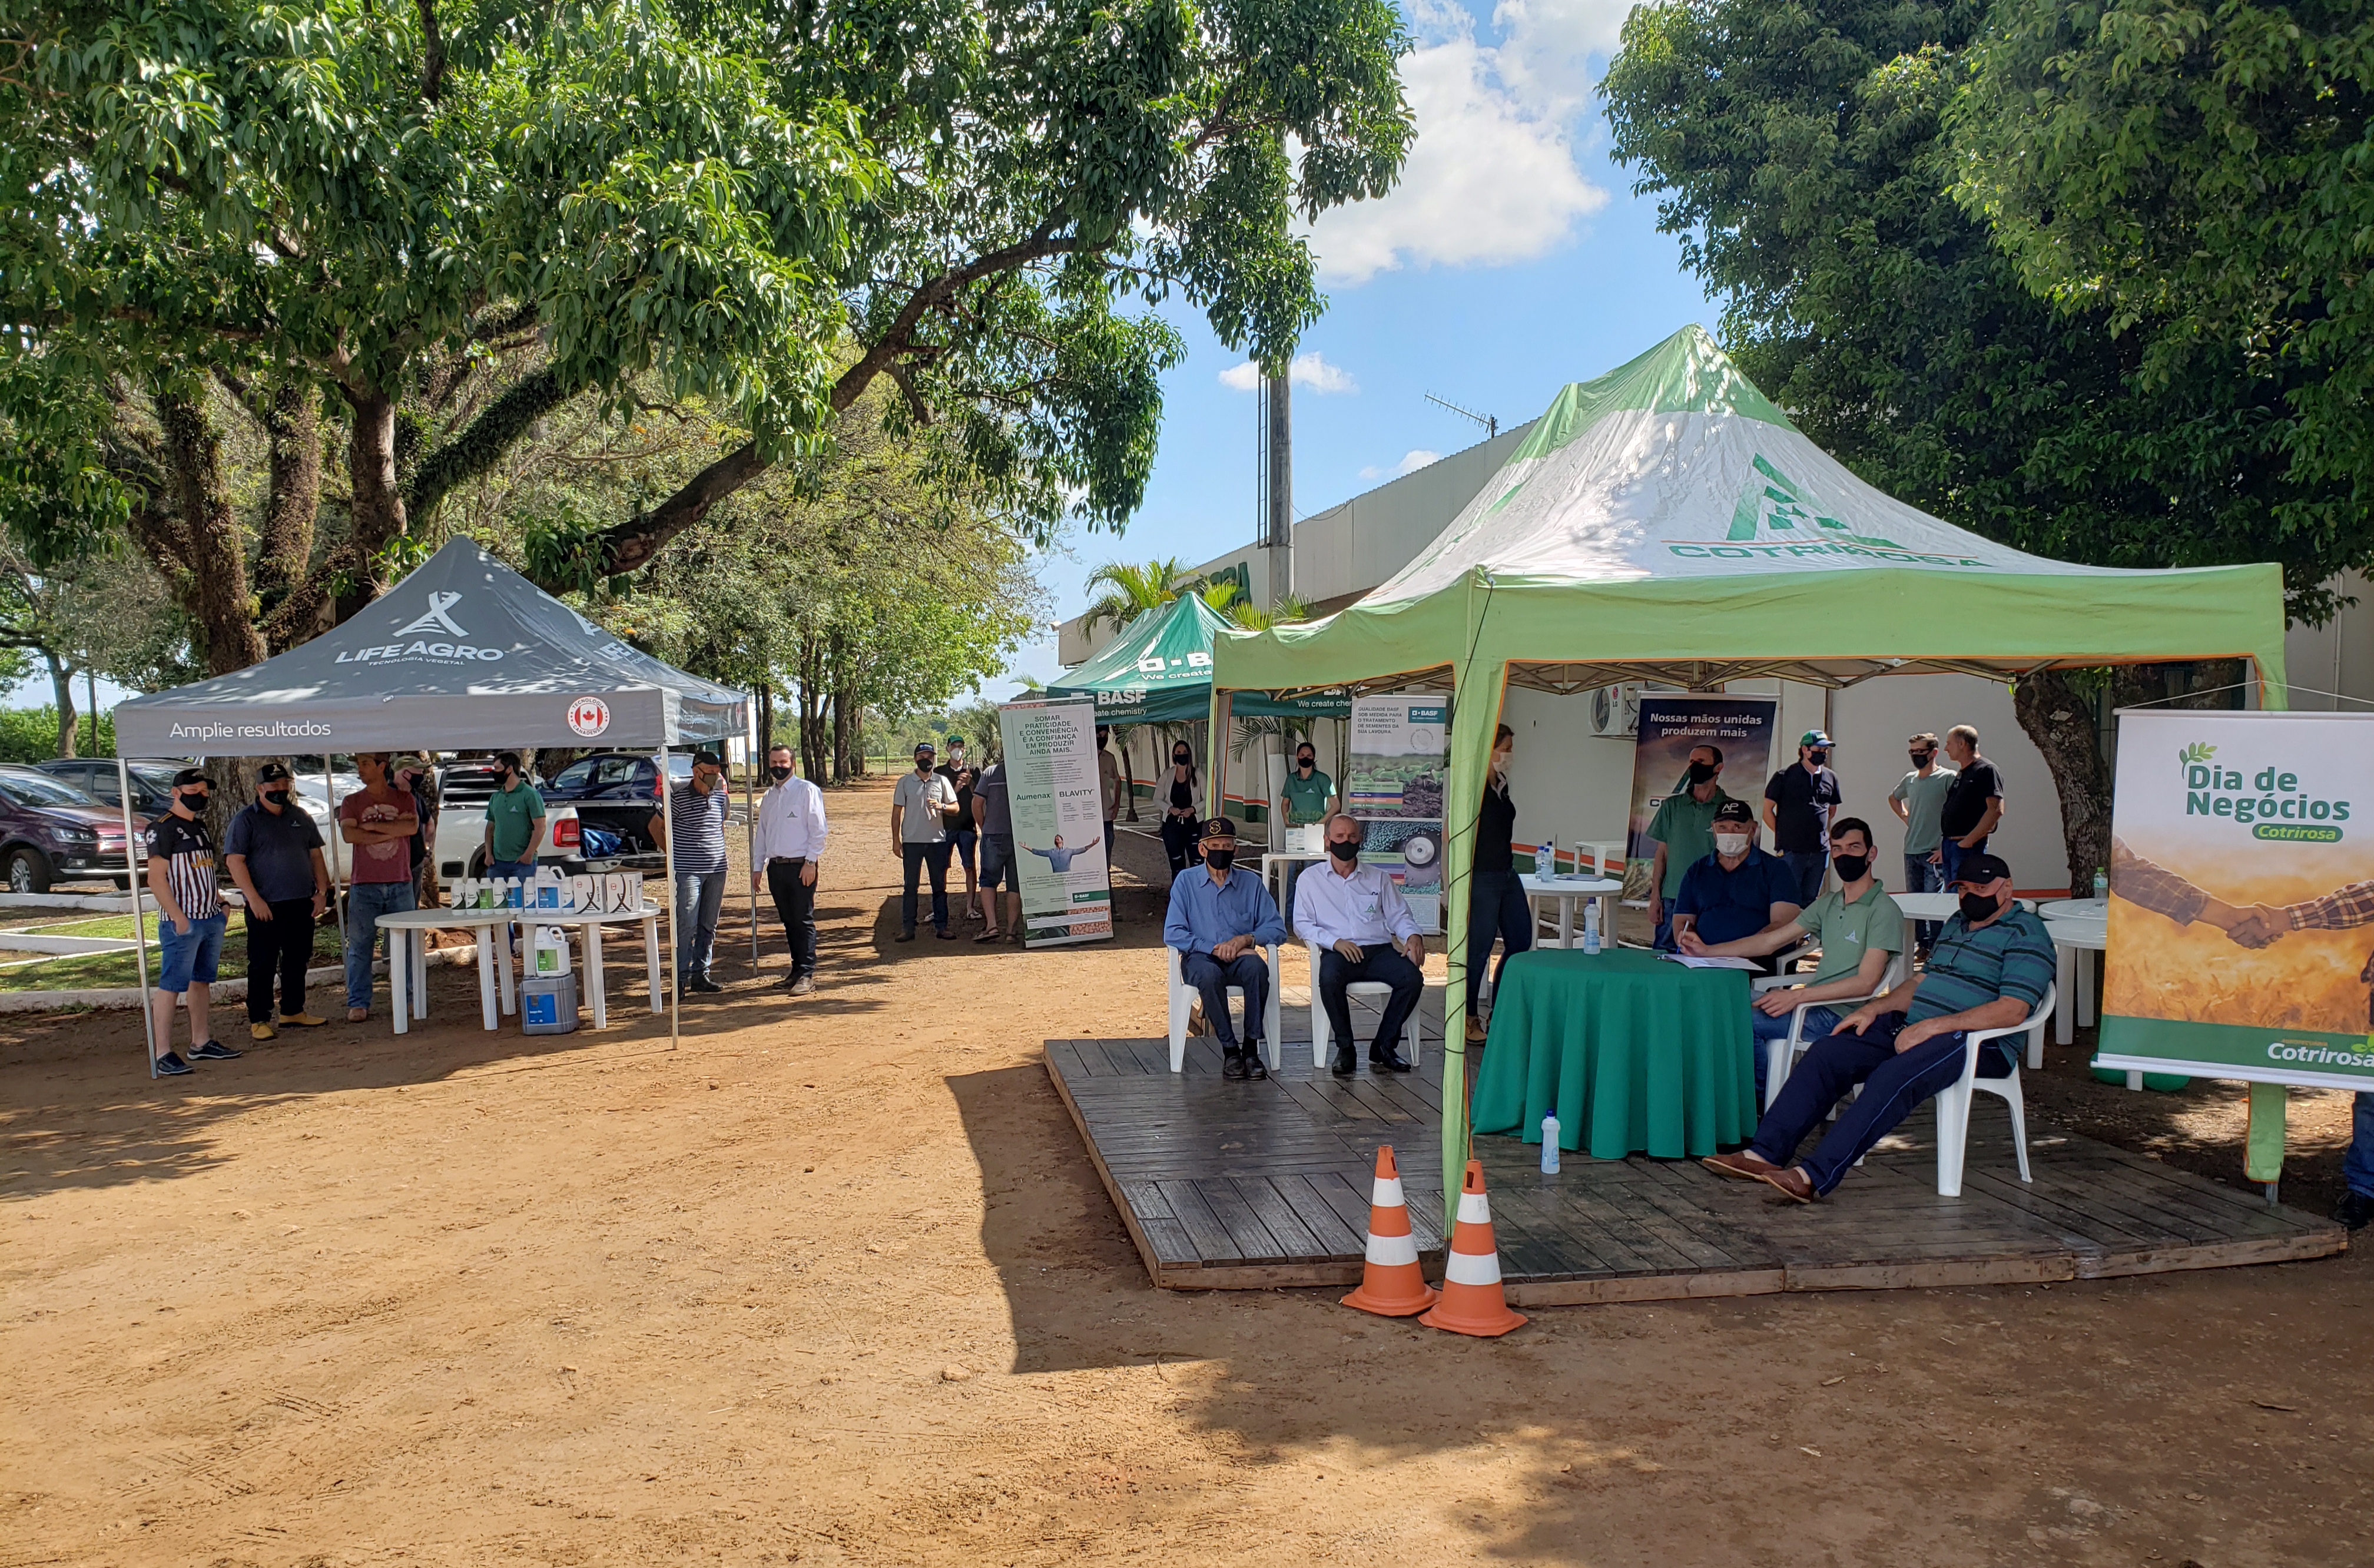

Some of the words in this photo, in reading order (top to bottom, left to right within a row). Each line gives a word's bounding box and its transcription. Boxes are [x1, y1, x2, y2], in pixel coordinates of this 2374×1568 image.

[1668, 542, 1998, 567] COTRIROSA
[334, 643, 404, 664] LIFE
[402, 641, 505, 661] AGRO
[1168, 670, 1212, 679] create
[1098, 689, 1147, 705] BASF
[572, 698, 604, 709] TECNOLOGIA
[1650, 713, 1687, 722] Nossas
[1690, 714, 1721, 724] mãos
[1723, 715, 1762, 725] unidas
[573, 725, 604, 735] CANADENSE
[1025, 721, 1072, 729] PRATICIDADE
[170, 722, 234, 742] Amplie
[238, 720, 331, 737] resultados
[1026, 727, 1079, 736] CONVENIÊNCIA
[1661, 727, 1716, 737] produzem
[1720, 728, 1748, 737] mais
[1036, 734, 1077, 742] CONFIANÇA
[1039, 740, 1075, 748] PRODUZIR
[2187, 765, 2243, 790] Dia
[2254, 766, 2298, 791] de
[1059, 789, 1093, 798] BLAVITY
[1722, 803, 1739, 812] AP
[2186, 791, 2350, 823] Negócios
[2258, 825, 2336, 840] Cotrirosa
[2267, 1042, 2374, 1068] Cotrirosa
